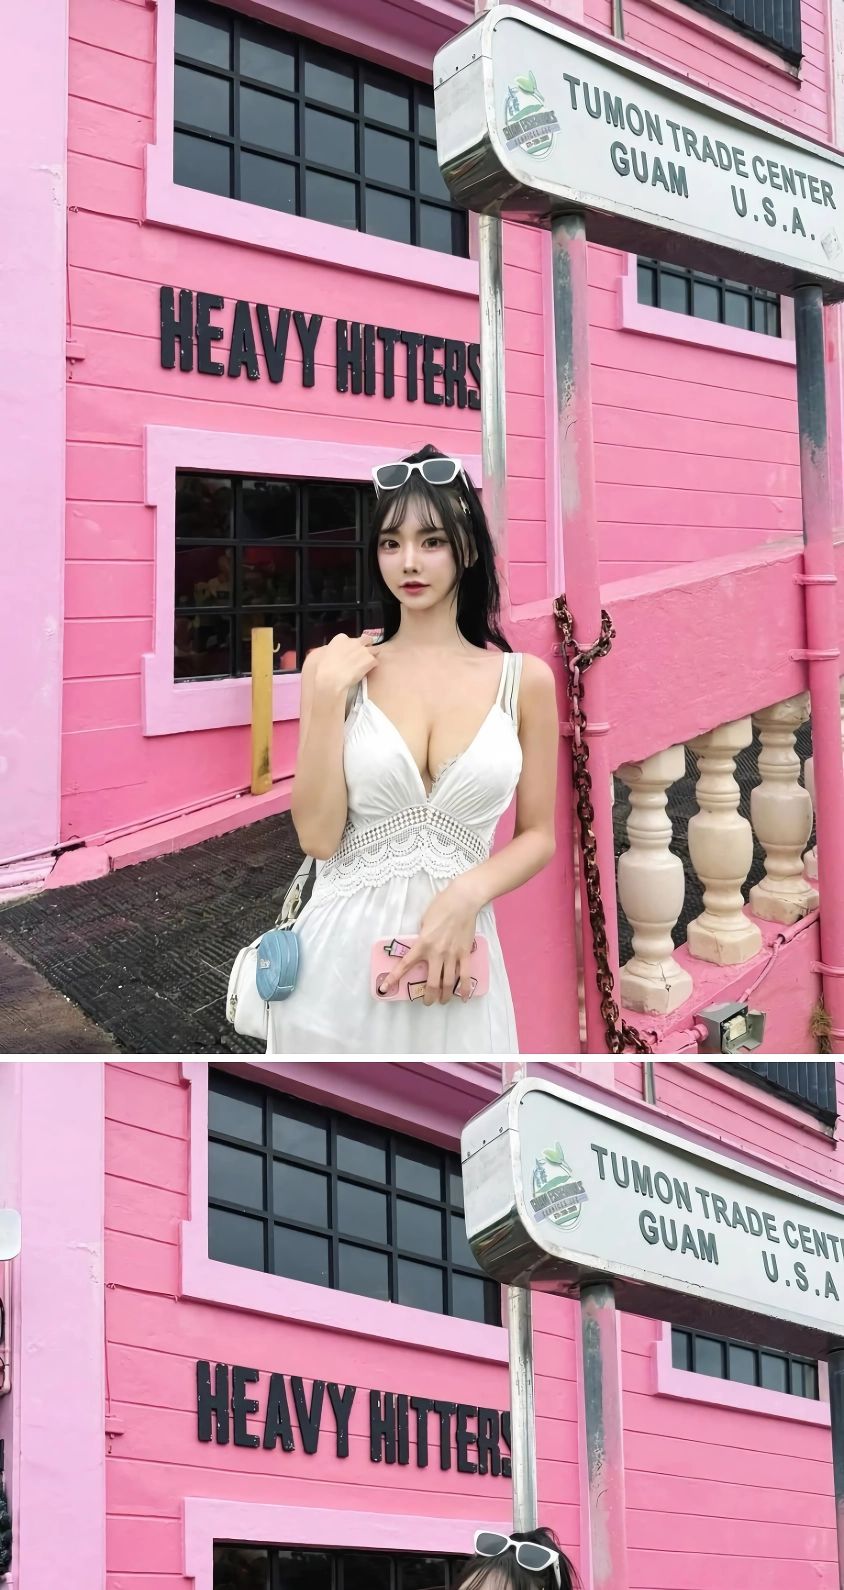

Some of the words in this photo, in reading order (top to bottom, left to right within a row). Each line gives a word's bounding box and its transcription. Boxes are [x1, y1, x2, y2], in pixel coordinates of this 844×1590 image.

[563, 72, 664, 146] TUMON
[666, 119, 748, 178] TRADE
[752, 154, 837, 210] CENTER
[610, 141, 690, 198] GUAM
[159, 286, 323, 388] HEAVY
[335, 318, 482, 411] HITTERS
[590, 1143, 693, 1213] TUMON
[695, 1187, 780, 1244] TRADE
[782, 1219, 844, 1264] CENT
[638, 1209, 720, 1265] GUAM
[196, 1360, 357, 1458] HEAVY
